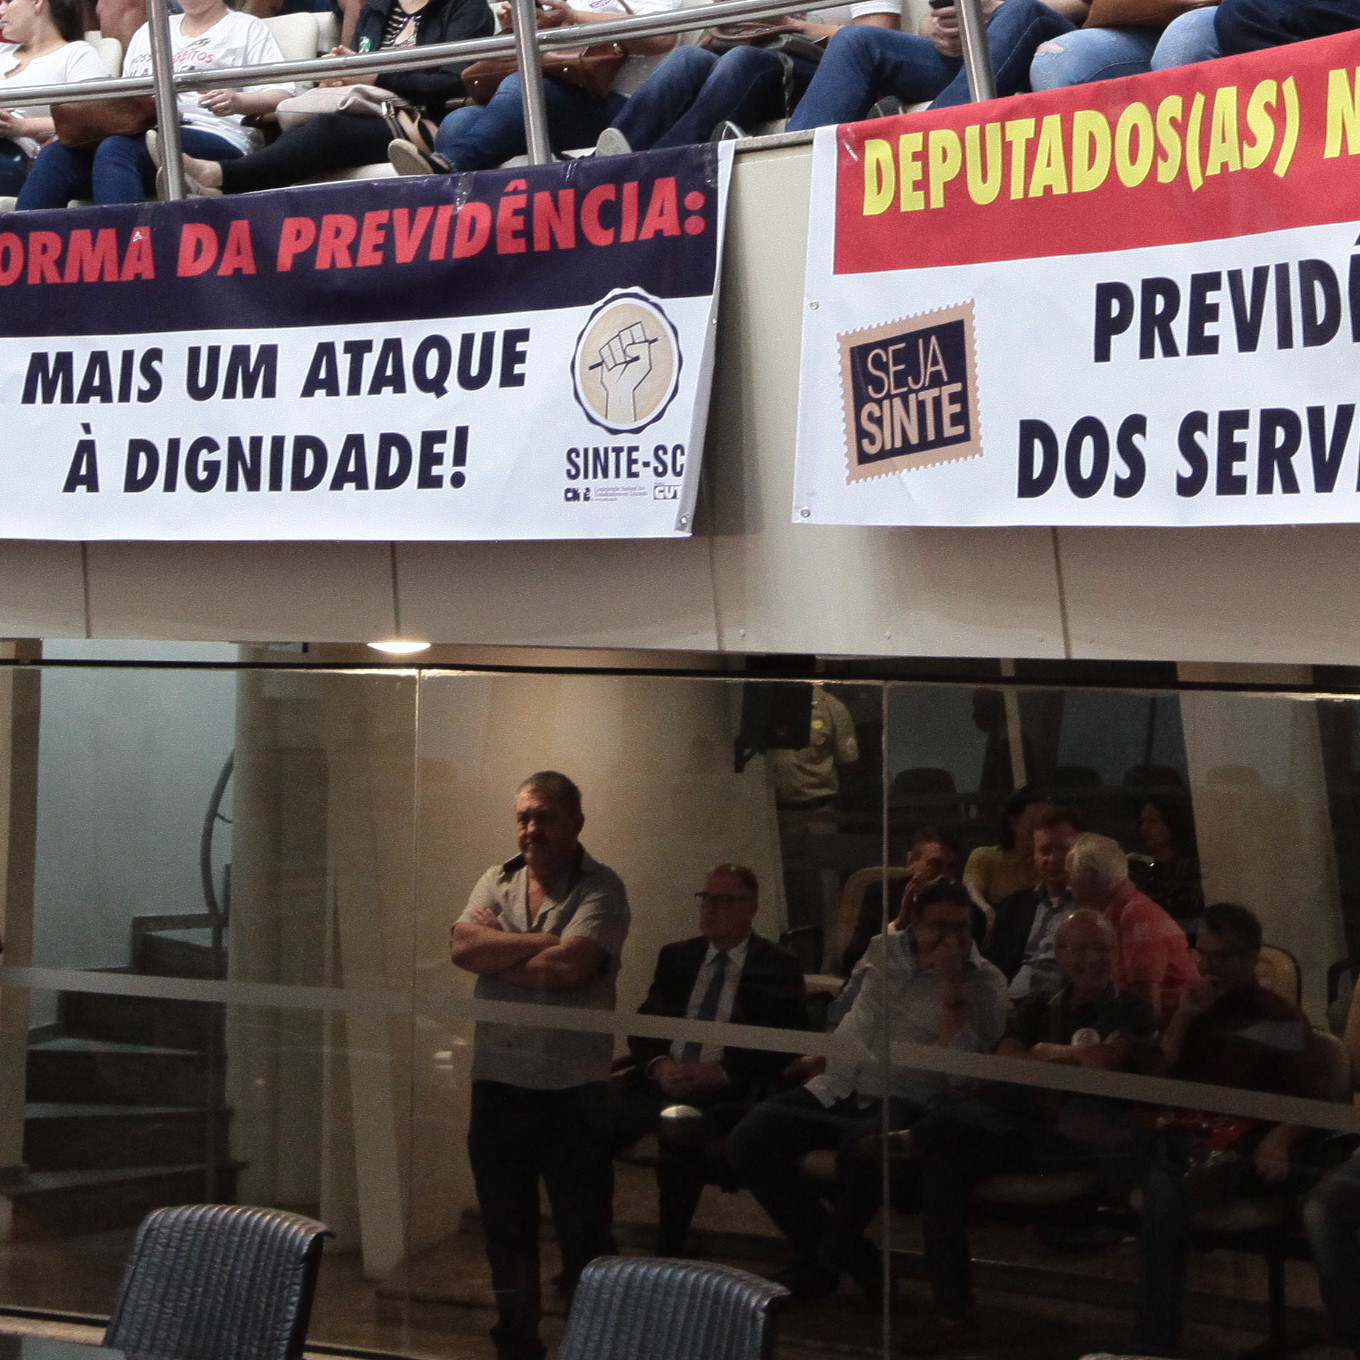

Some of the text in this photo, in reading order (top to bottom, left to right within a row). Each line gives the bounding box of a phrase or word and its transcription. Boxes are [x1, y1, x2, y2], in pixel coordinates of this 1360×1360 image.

[862, 75, 1300, 217] DEPUTADOS(AS)
[176, 219, 257, 278] DA
[276, 176, 707, 272] PREVIDÊNCIA:
[20, 328, 531, 405] MAIS UM ATAQUE
[867, 335, 948, 399] SEJA
[860, 382, 965, 455] SINTE
[1017, 413, 1148, 499] DOS
[61, 422, 470, 494] À DIGNIDADE!
[565, 444, 685, 481] SINTE-SC
